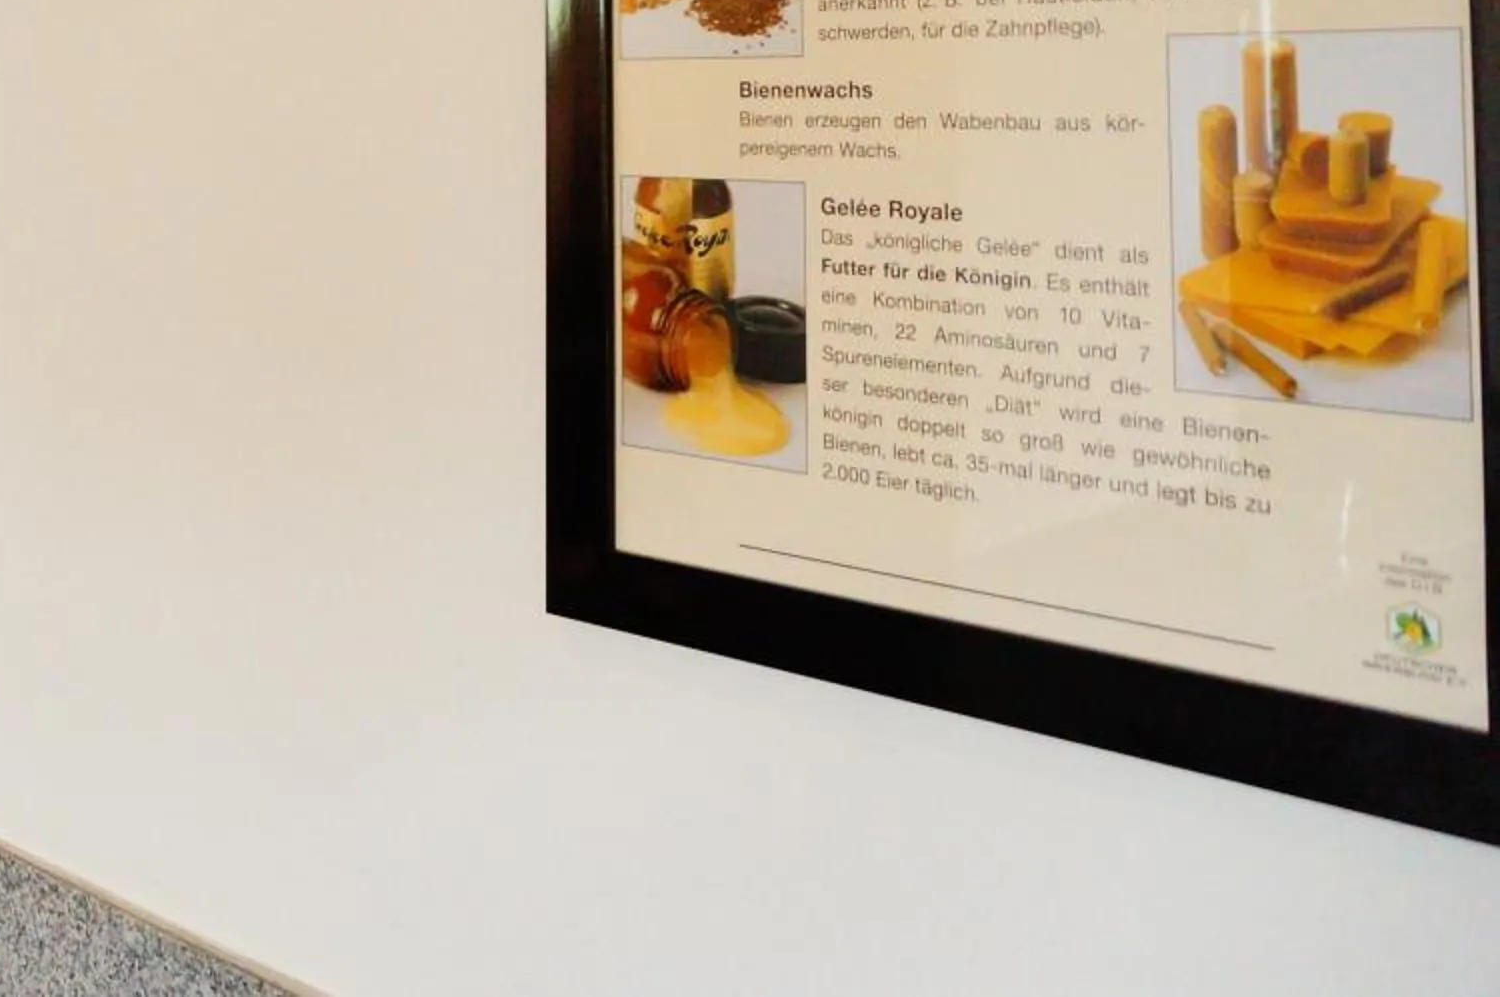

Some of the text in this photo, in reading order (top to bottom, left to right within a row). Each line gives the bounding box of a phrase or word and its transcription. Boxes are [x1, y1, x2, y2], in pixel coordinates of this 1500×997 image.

[817, 20, 915, 43] schwerden,
[920, 20, 947, 40] für
[950, 20, 980, 39] die
[739, 79, 874, 100] Bienenwachs
[739, 109, 1145, 134] Bienen erzeugen den Wabenbau aus kör-
[738, 140, 834, 161] pereigenem
[820, 196, 963, 225] Gelée Royale
[820, 227, 855, 248] Das
[1054, 241, 1105, 263] dient
[1119, 246, 1150, 266] als
[821, 256, 877, 278] Futter
[882, 261, 911, 281] für
[916, 263, 948, 283] die
[1046, 272, 1071, 293] Es
[1079, 277, 1149, 297] enthält
[820, 286, 1151, 331] eine Kombination von 10 Vita-
[821, 317, 1151, 364] minen, 22 Aminosäuren und 7
[821, 343, 1151, 397] Spurenelementen. Aufgrund die-
[821, 377, 850, 395] ser
[862, 377, 970, 410] besonderen
[1058, 405, 1102, 426] wird
[1118, 410, 1165, 434] eine
[1182, 415, 1270, 444] Bienen-
[822, 403, 1272, 482] königin doppelt so groß wie gewöhnliche
[821, 461, 980, 503] 2.000 Eier täglich.
[822, 431, 1272, 516] Bienen, lebt ca. 35-mal länger und legt bis zu
